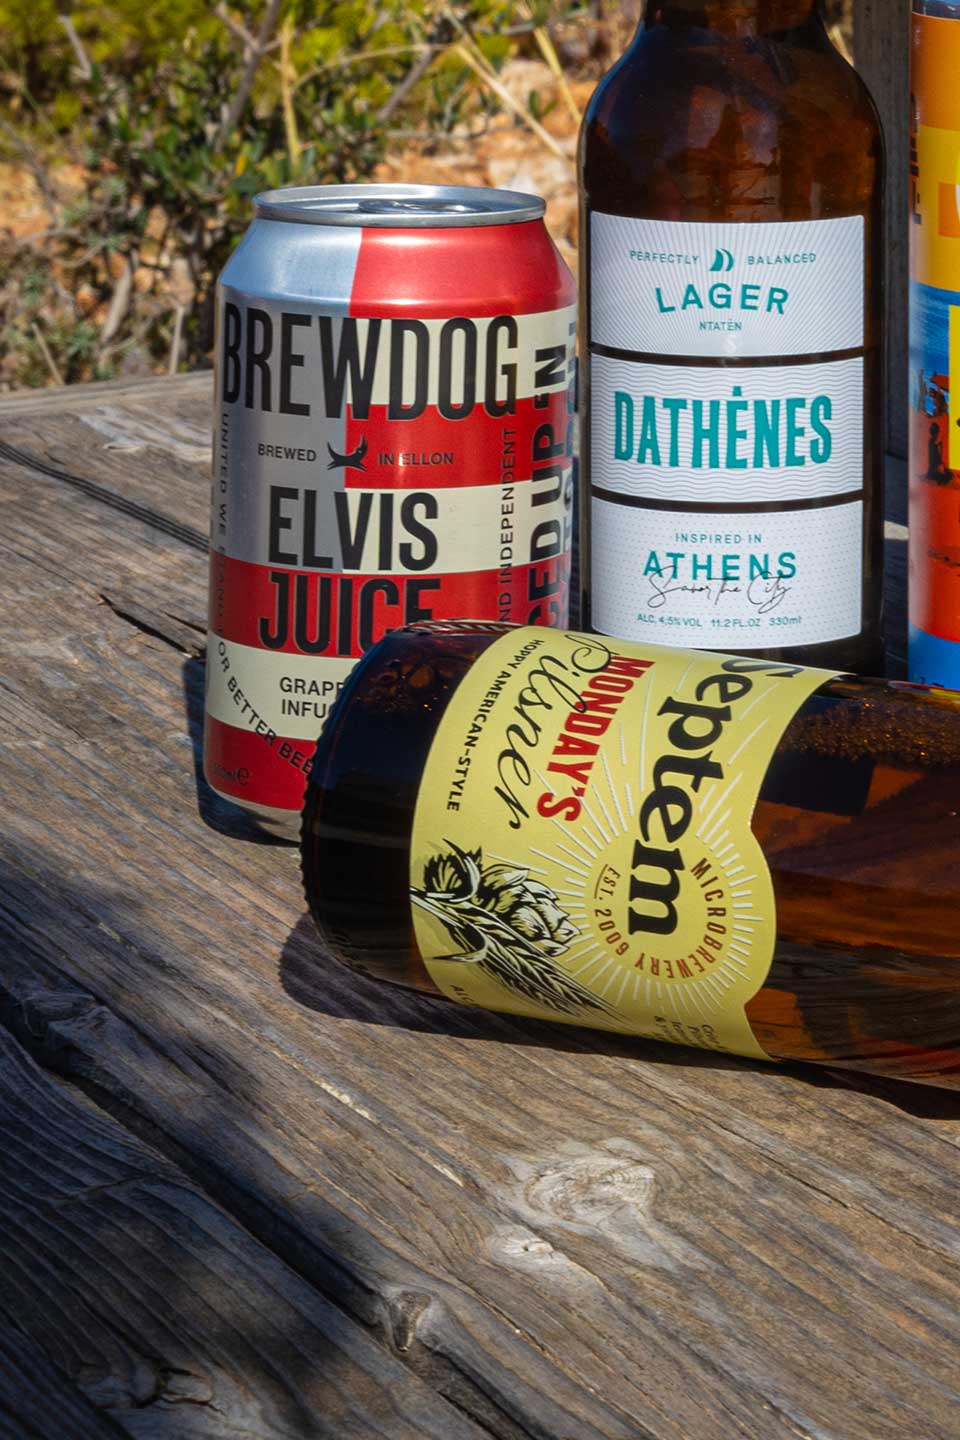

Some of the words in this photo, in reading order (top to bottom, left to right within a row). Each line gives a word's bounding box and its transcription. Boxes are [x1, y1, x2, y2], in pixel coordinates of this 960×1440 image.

[629, 249, 699, 265] PERFECTLY
[747, 252, 817, 266] BALANCED
[655, 282, 789, 315] LAGER
[223, 301, 518, 420] BREWDOG
[218, 413, 229, 495] UNITED
[257, 443, 317, 462] BREWED
[377, 453, 394, 466] IN
[398, 452, 454, 467] ELLON
[531, 423, 565, 507] UP
[217, 502, 228, 535] WE
[268, 485, 439, 572] ELVIS
[500, 427, 516, 584] INDEPENDENT
[675, 532, 742, 545] INSPIRED
[748, 533, 763, 545] IN
[642, 550, 797, 582] ATHENS
[507, 639, 544, 670] HOPPY
[226, 675, 277, 747] BETTER
[446, 671, 512, 812] AMERICAN-STYLE
[494, 634, 621, 830] Pilsner
[536, 655, 656, 822] MONDAY'S
[278, 742, 313, 776] BEE
[628, 658, 804, 936] Septem
[599, 866, 621, 901] EST.
[634, 858, 727, 979] MICROBREWERY
[594, 908, 630, 956] 2009
